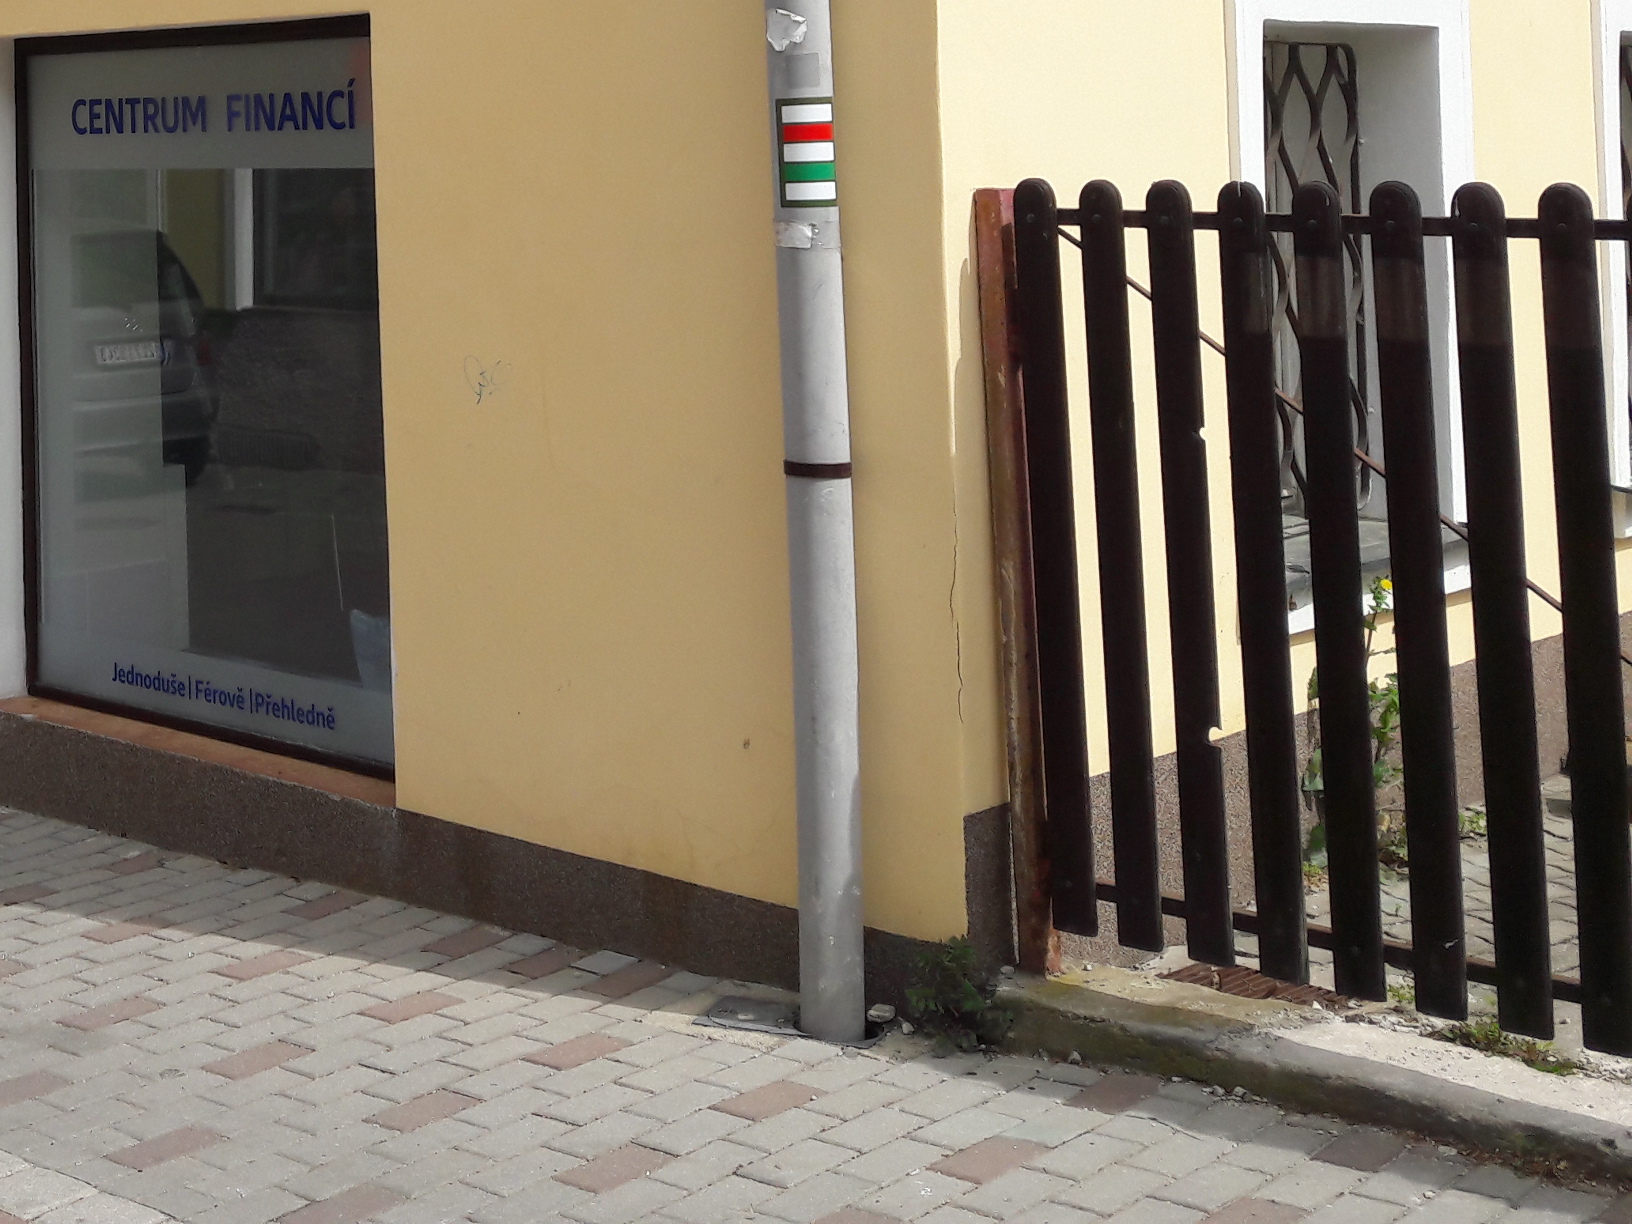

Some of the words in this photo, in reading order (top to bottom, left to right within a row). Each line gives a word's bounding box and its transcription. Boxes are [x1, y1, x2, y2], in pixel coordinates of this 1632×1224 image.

[72, 94, 207, 135] CENTRUM
[226, 78, 356, 132] FINANCÍ
[195, 680, 245, 710] Férově
